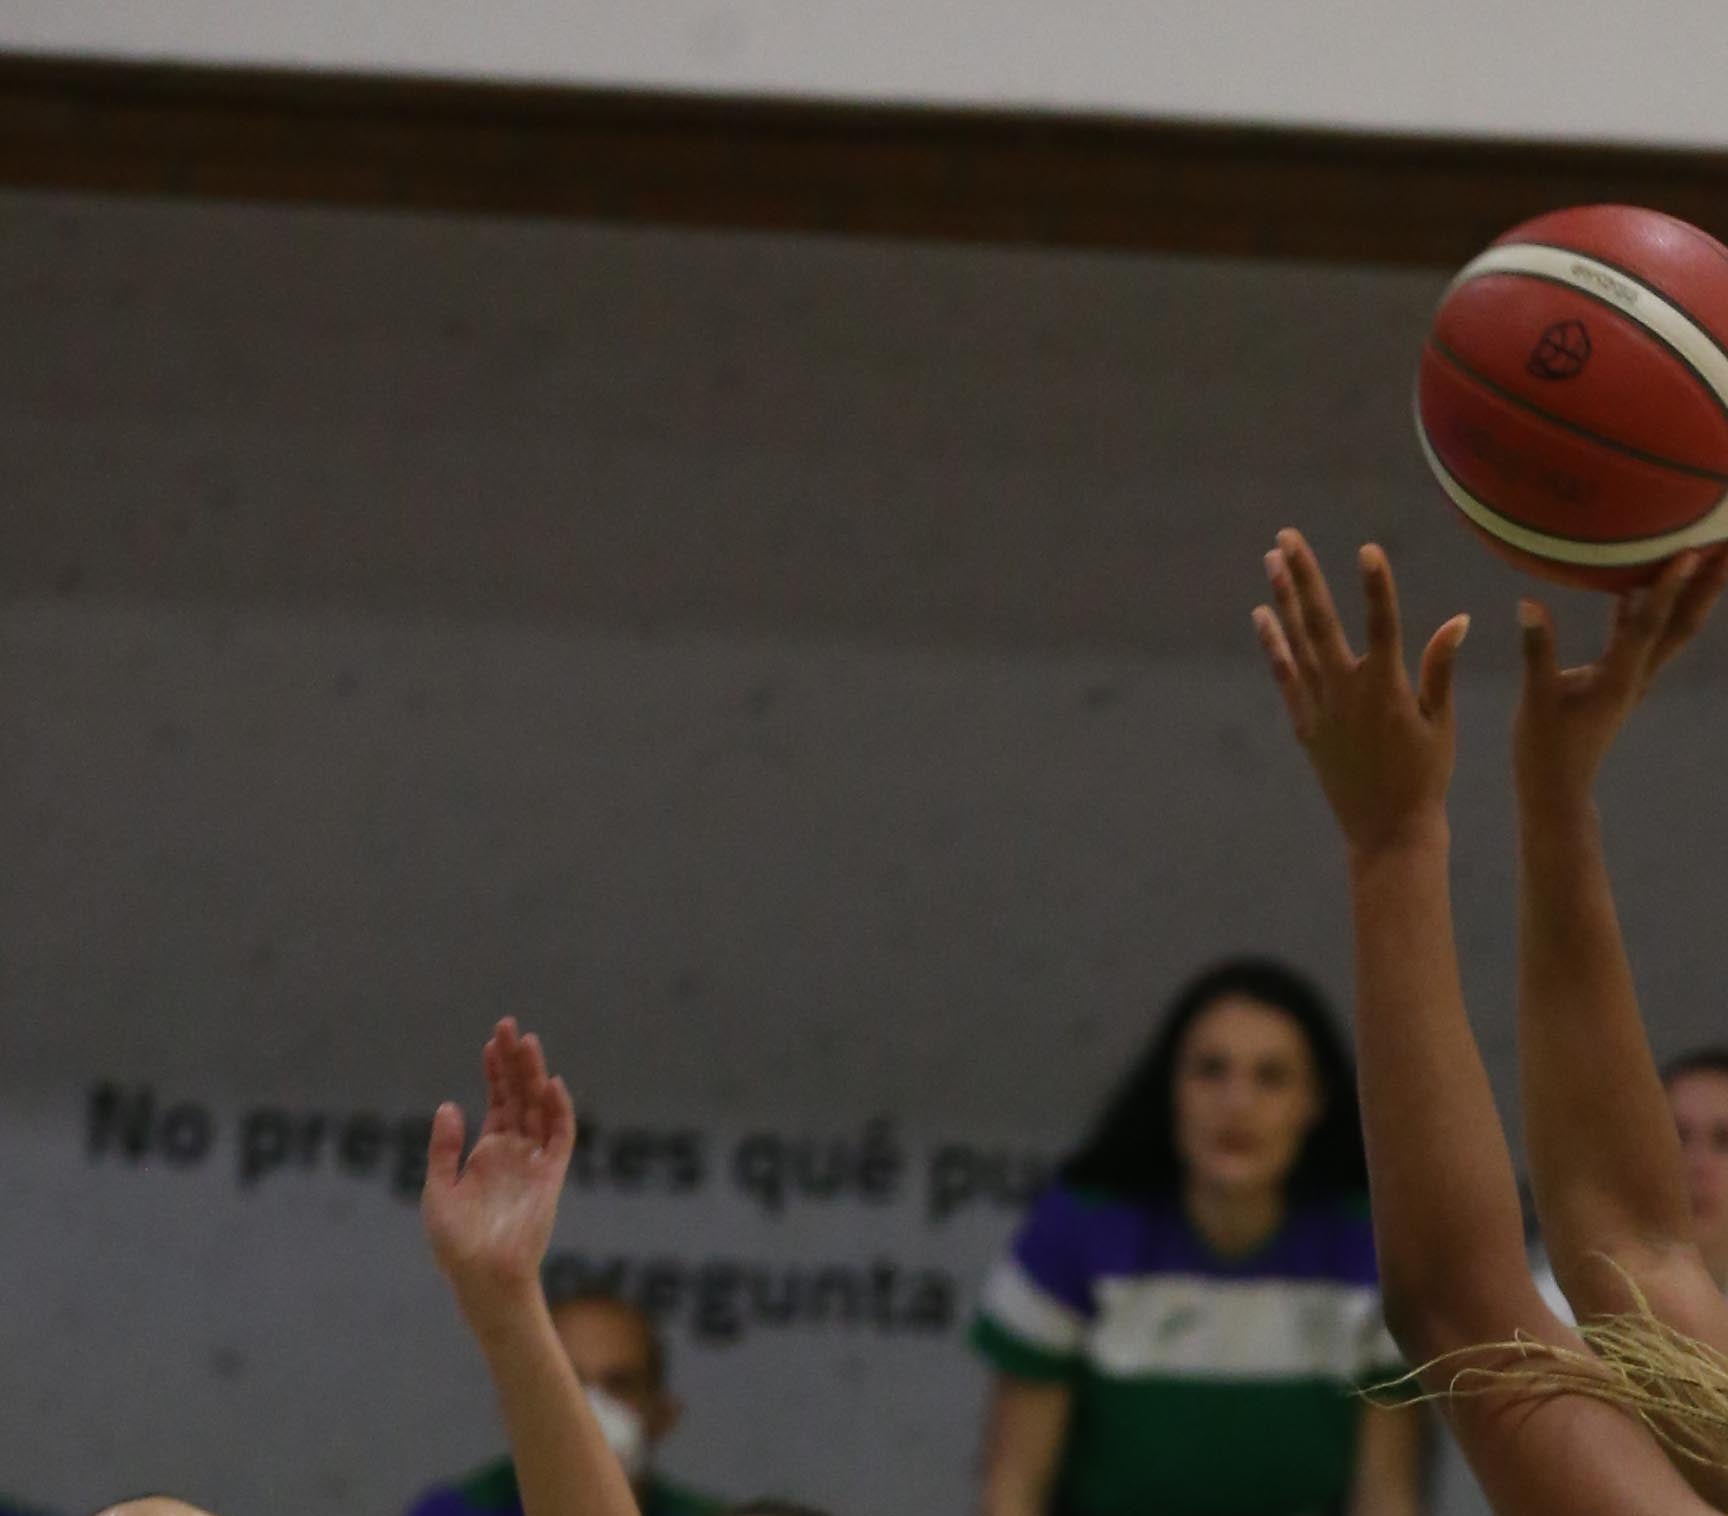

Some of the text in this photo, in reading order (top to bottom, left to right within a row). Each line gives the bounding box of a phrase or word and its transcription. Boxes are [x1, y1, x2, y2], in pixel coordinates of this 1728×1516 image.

[88, 1080, 212, 1166] No
[238, 1104, 702, 1196] pregtes
[734, 1112, 906, 1210] qué
